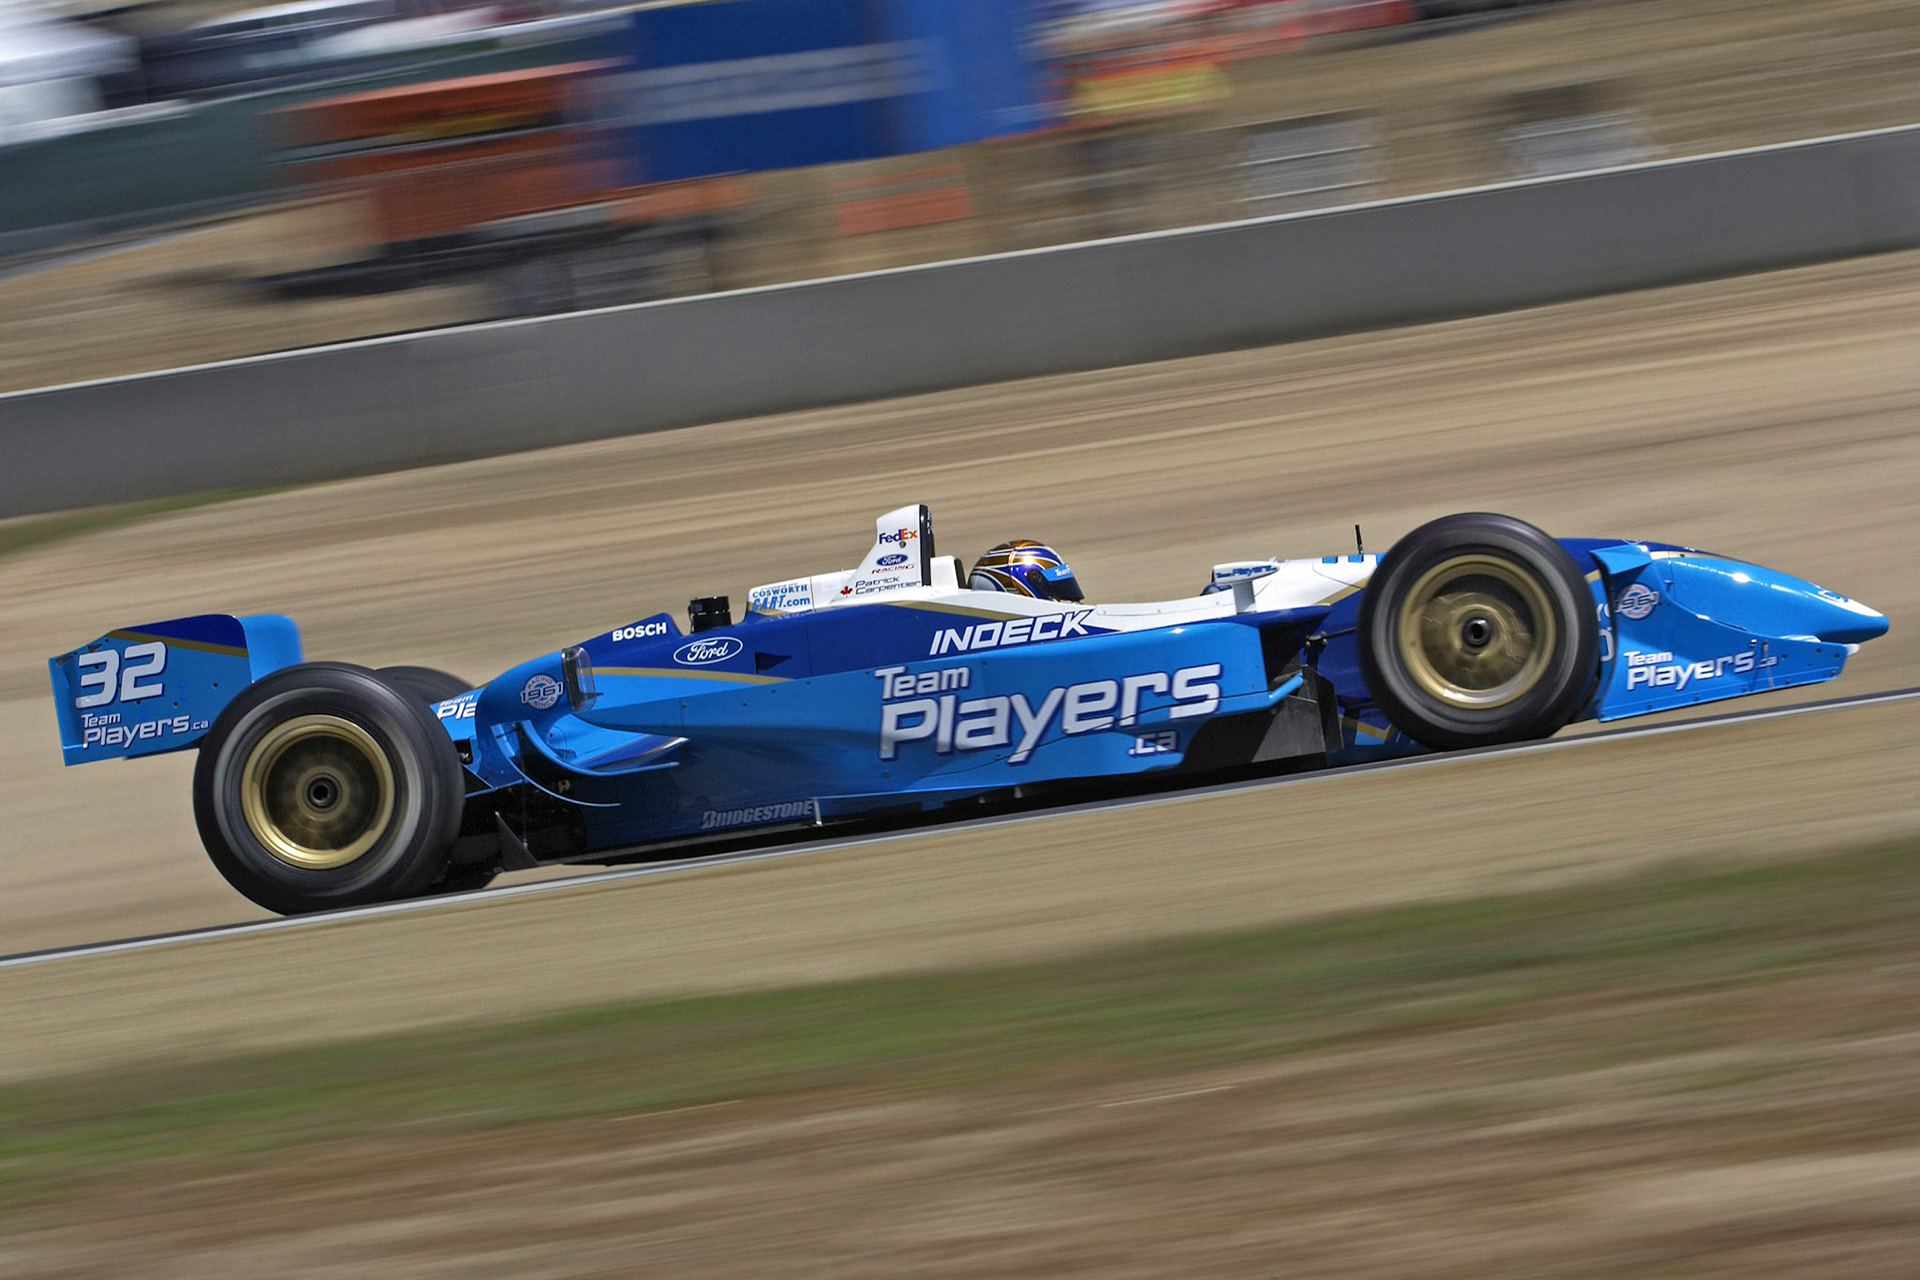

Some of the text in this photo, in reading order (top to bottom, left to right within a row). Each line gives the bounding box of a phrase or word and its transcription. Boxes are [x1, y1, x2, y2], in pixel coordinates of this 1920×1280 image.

[879, 528, 918, 544] FedEx
[871, 564, 915, 574] RACING
[881, 555, 903, 566] Ford
[752, 584, 808, 598] COSWORTH
[855, 576, 900, 588] Patrick
[855, 580, 921, 595] Carpentier
[612, 622, 667, 642] BOSCH
[929, 608, 1096, 656] INDECK
[686, 640, 729, 662] Ford
[1624, 651, 1673, 667] Team
[75, 641, 167, 709] 32
[874, 665, 971, 700] Team
[521, 682, 563, 703] 1961
[81, 712, 121, 728] Team
[878, 663, 1222, 764] Players
[701, 801, 814, 830] BRIDGESTONE
